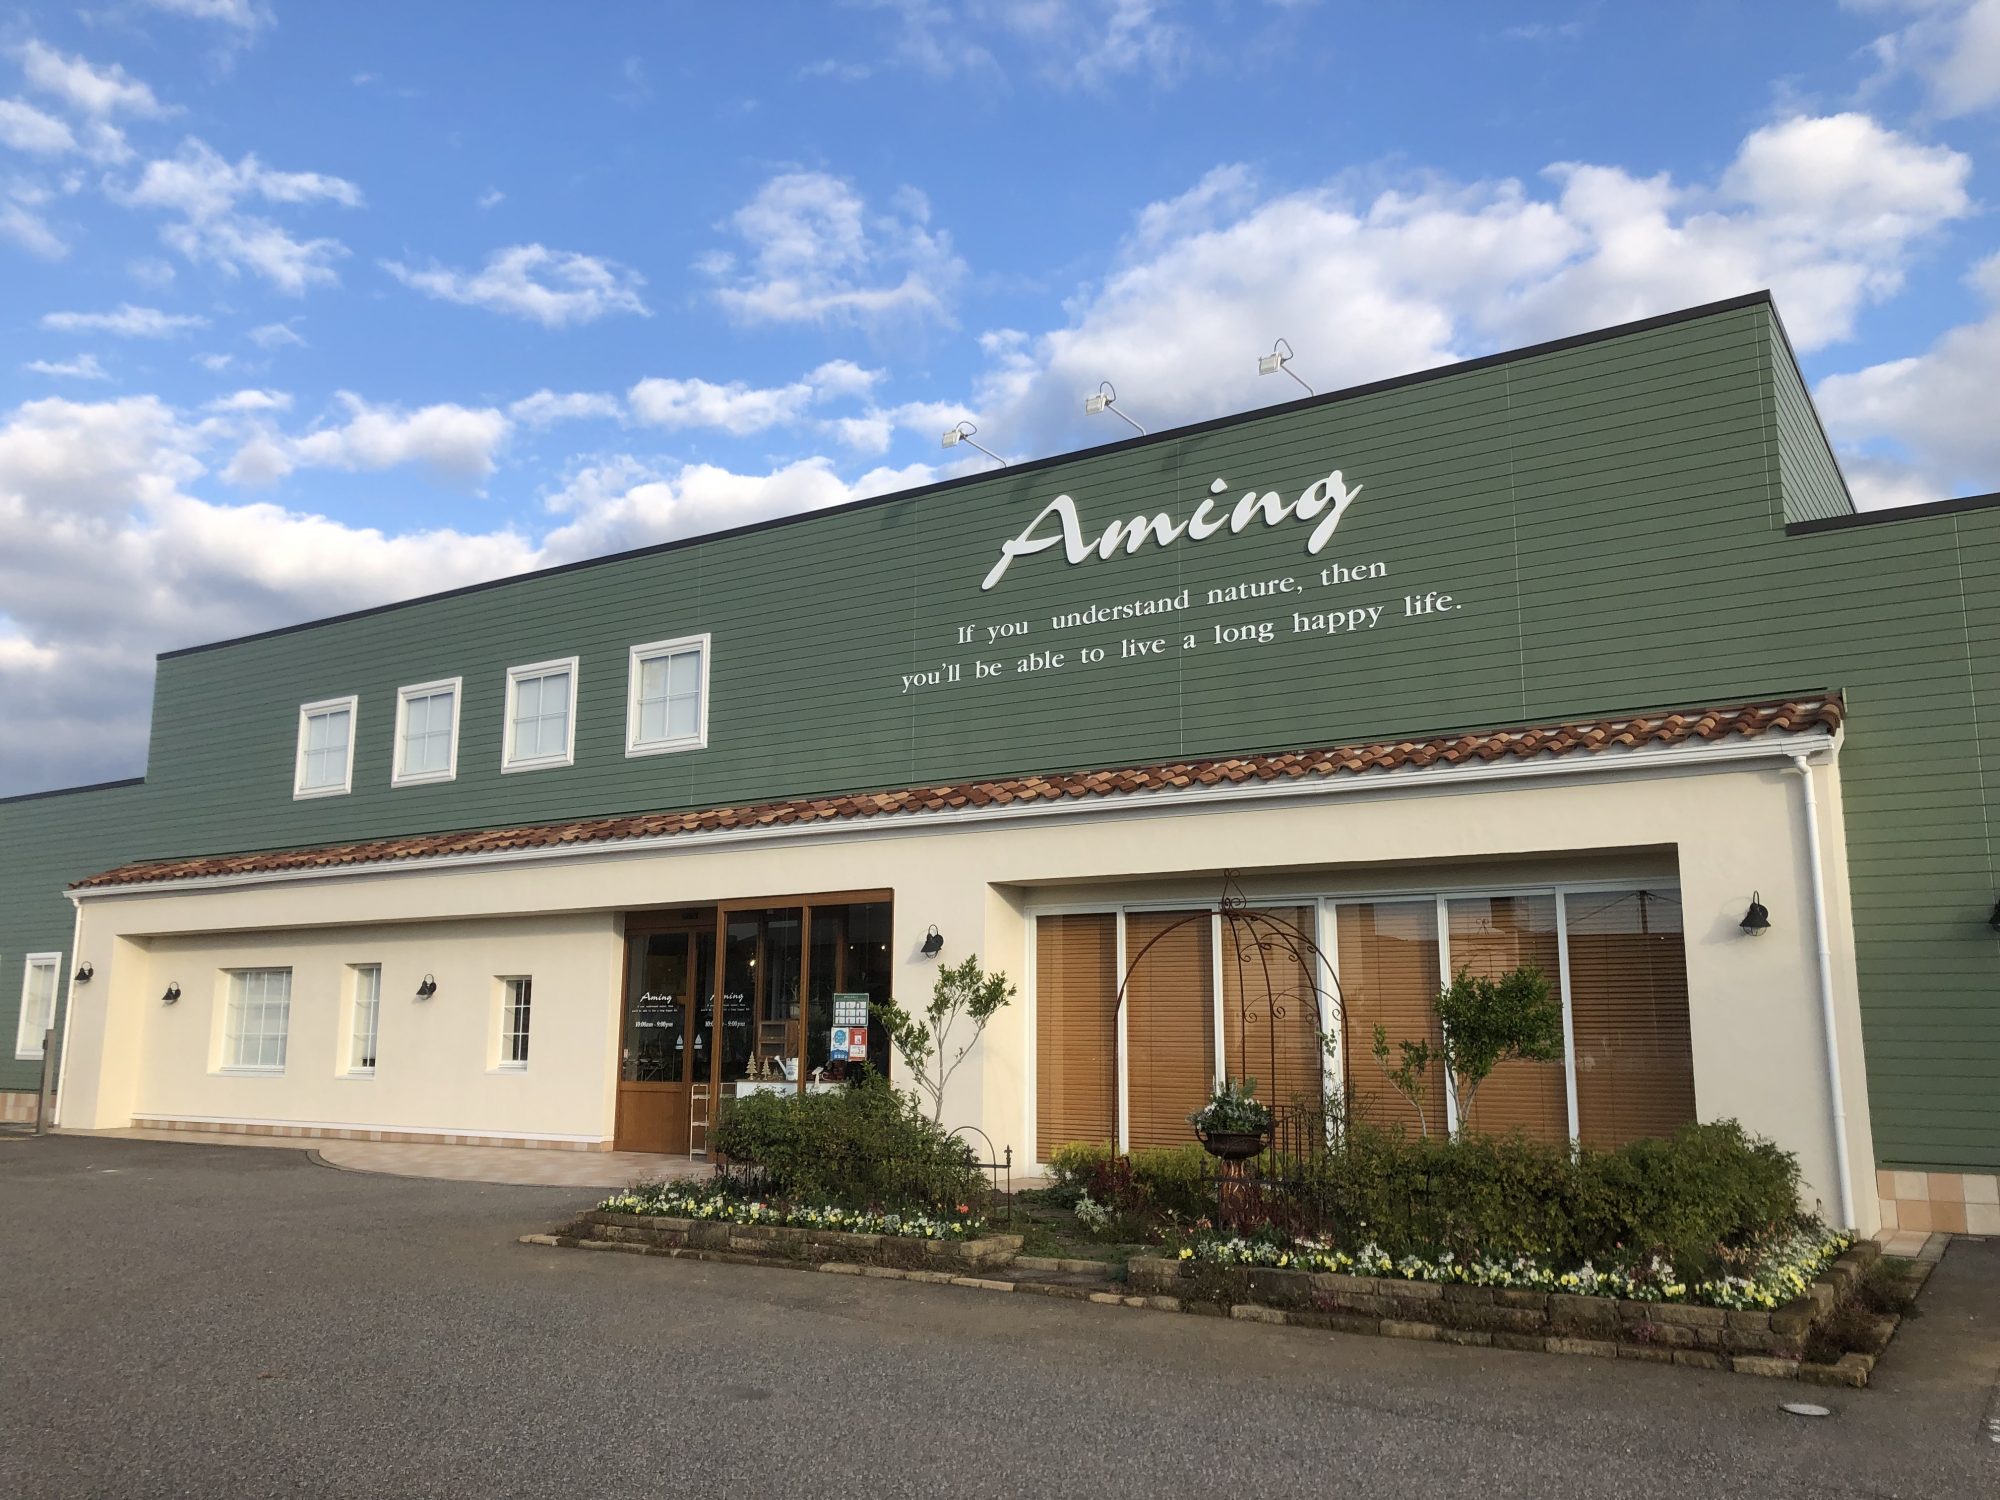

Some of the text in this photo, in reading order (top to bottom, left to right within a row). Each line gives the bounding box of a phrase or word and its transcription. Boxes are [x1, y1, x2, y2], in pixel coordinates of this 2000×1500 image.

[981, 469, 1364, 590] Aming
[901, 591, 1462, 694] you'll be able to live a long happy life.
[957, 561, 1388, 646] If you understand nature, then
[639, 991, 672, 1004] Aming
